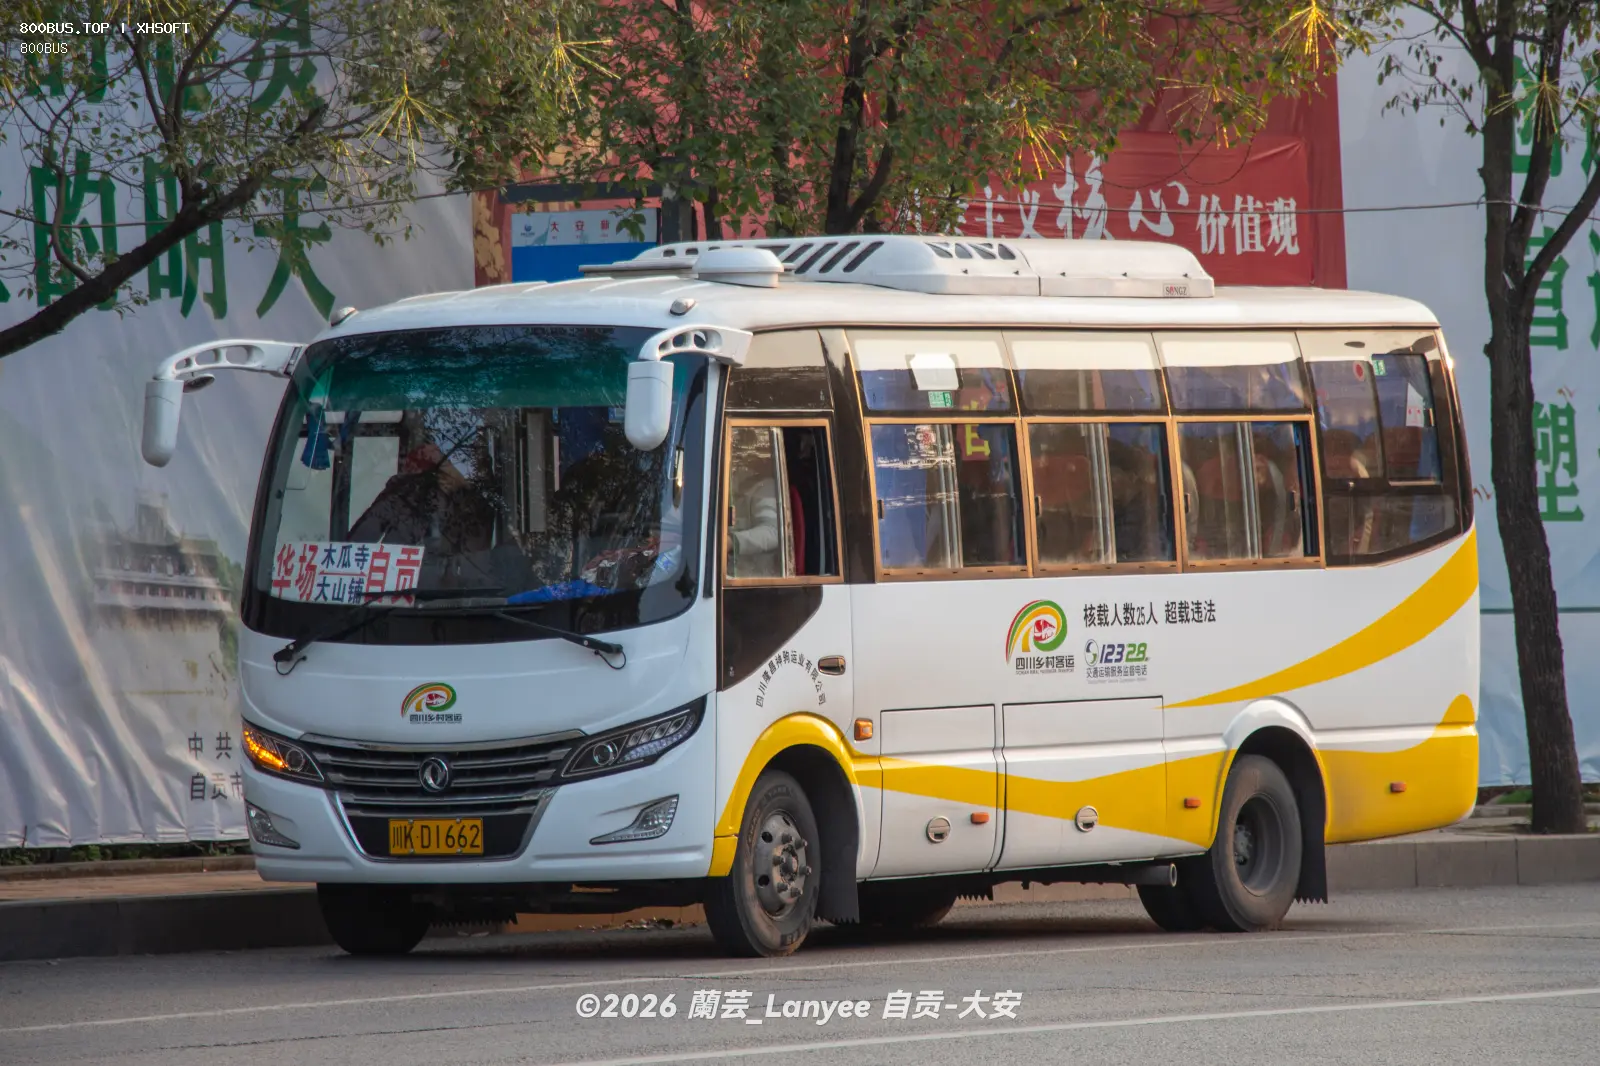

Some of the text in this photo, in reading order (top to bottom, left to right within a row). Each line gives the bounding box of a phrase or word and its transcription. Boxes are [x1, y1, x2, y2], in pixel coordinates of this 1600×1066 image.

[908, 150, 1300, 256] 主义核心价值观
[321, 544, 370, 570] 木瓜寺
[272, 543, 319, 601] 华场
[363, 545, 421, 604] 自贡
[1083, 599, 1216, 628] 核载人数25人 超载违法
[1015, 655, 1075, 669] 四川乡村客运
[1086, 665, 1148, 679] 交通运输服务监督电话
[409, 713, 463, 722] 四川乡村客运
[188, 731, 232, 760] 中共
